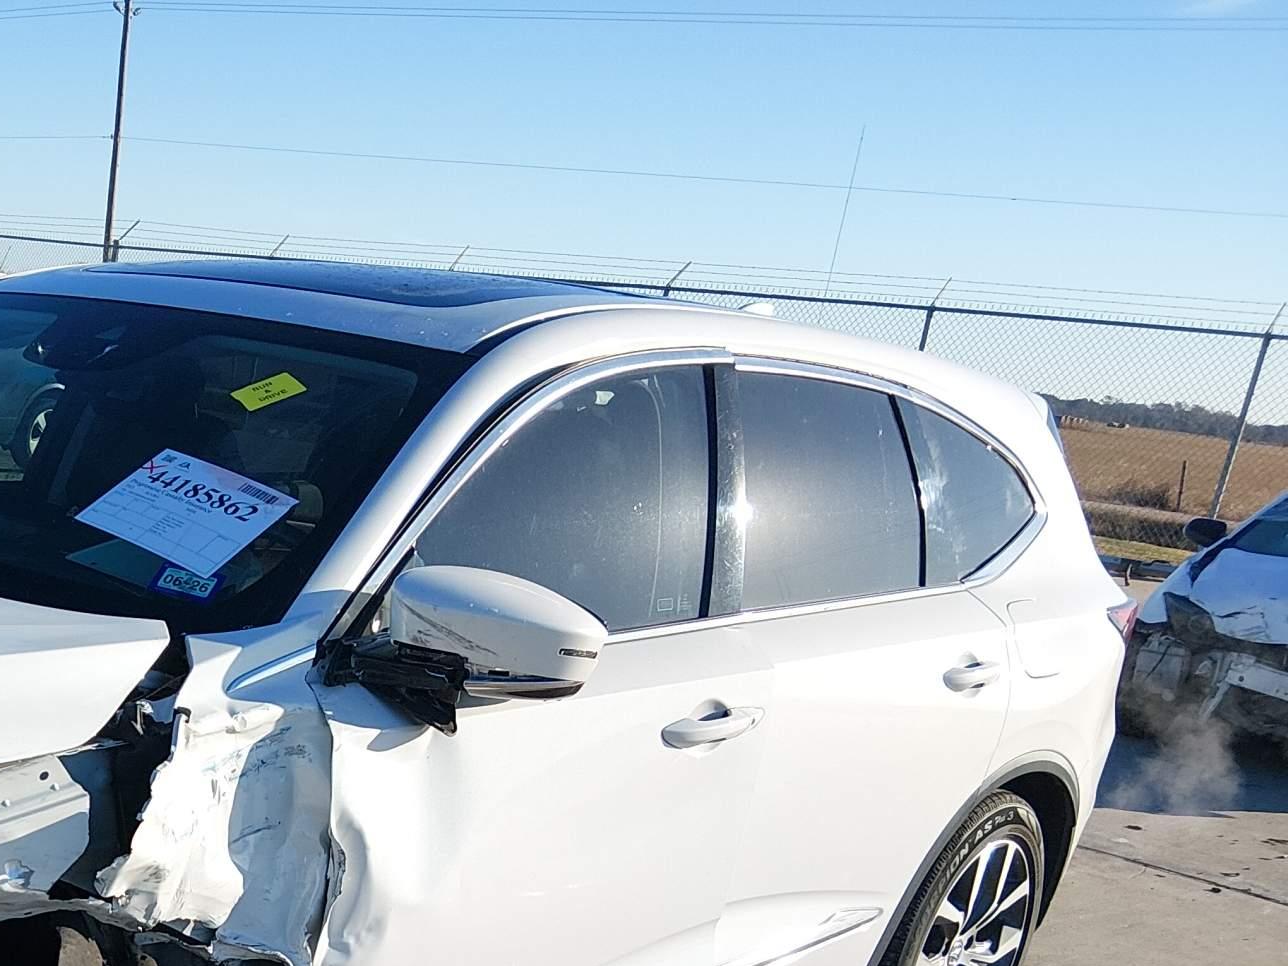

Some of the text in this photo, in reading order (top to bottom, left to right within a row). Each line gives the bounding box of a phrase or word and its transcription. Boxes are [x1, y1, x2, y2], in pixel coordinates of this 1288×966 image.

[251, 381, 273, 392] RUN
[258, 388, 289, 402] DRIVE
[147, 470, 259, 522] 44185862
[974, 819, 993, 844] AS
[1007, 810, 1015, 822] 3
